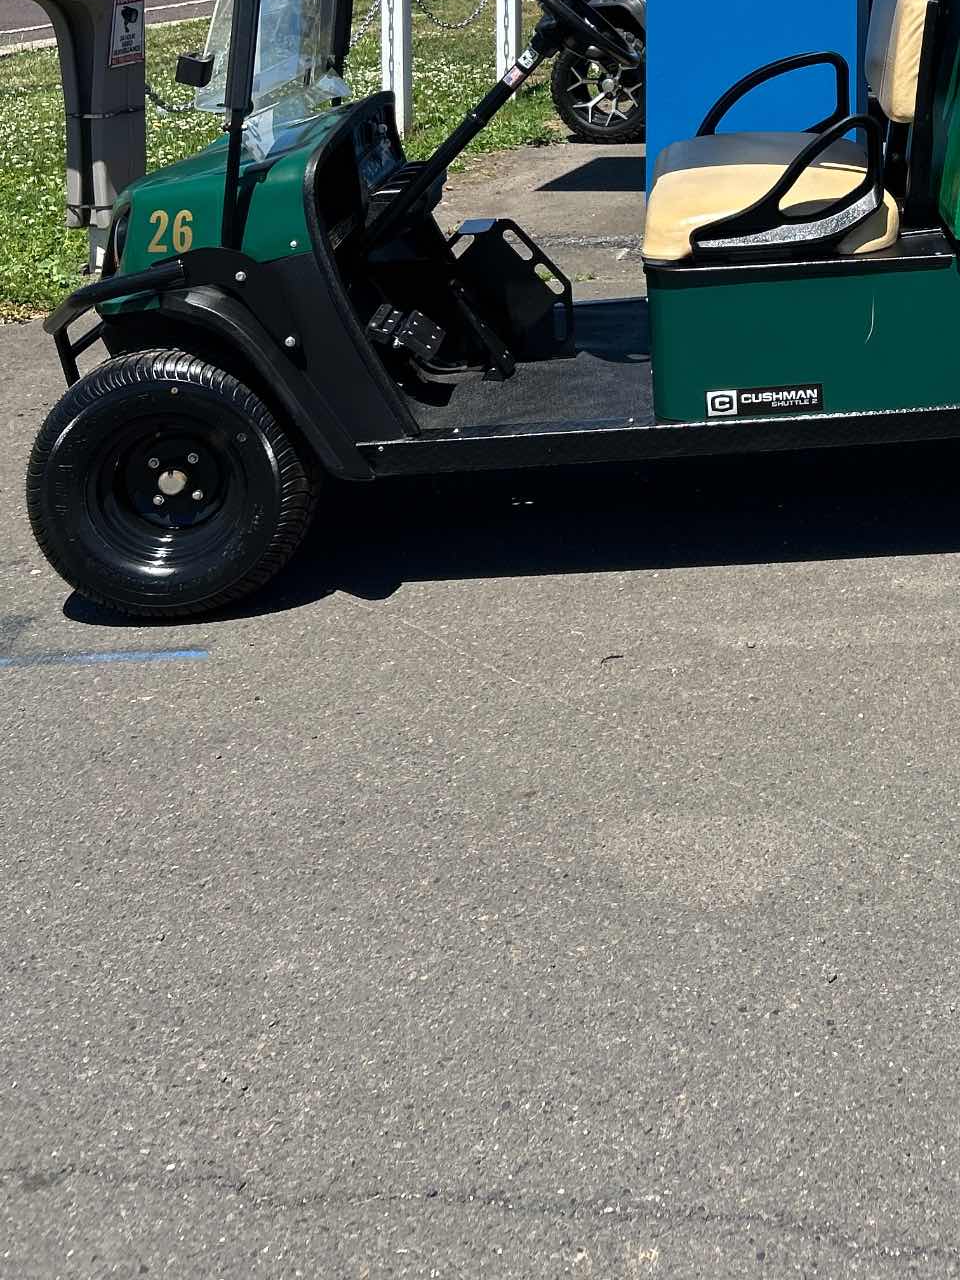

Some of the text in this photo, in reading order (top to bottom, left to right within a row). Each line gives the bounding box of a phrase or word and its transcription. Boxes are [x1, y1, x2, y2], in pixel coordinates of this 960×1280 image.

[148, 209, 193, 253] 26
[741, 389, 818, 404] CUSHMAN
[771, 399, 810, 408] SHUTTLE
